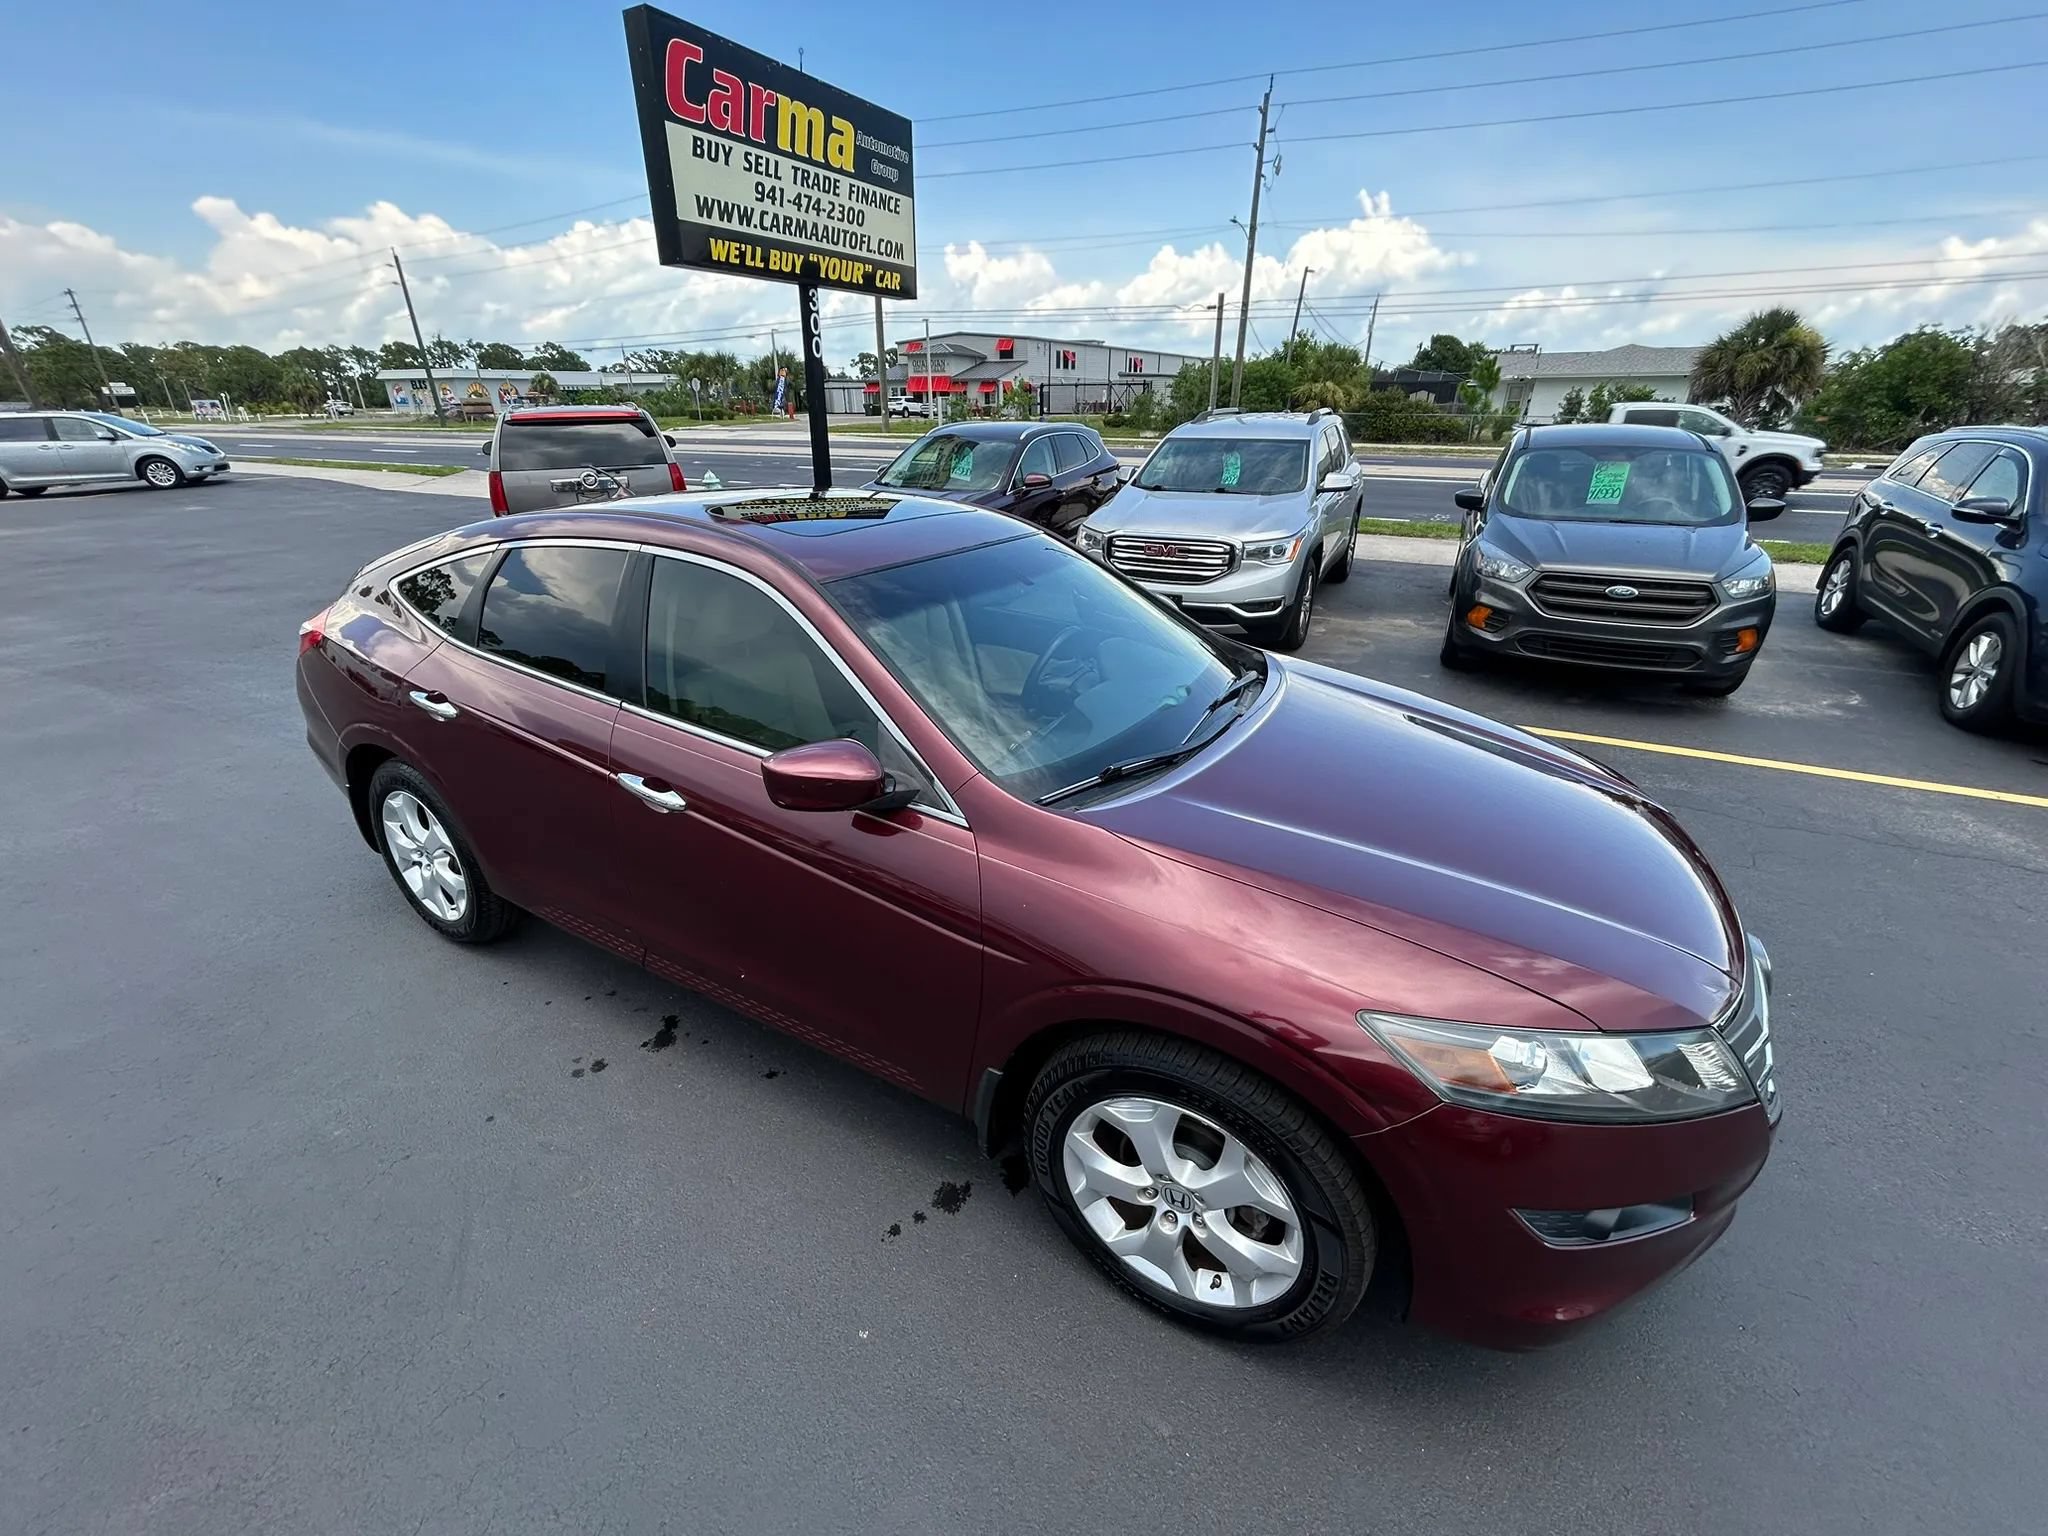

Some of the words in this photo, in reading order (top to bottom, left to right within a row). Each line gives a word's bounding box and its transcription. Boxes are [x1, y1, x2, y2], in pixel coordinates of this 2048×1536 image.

[665, 38, 855, 173] Carma
[856, 130, 910, 164] Automotive
[870, 158, 899, 183] Group
[692, 135, 733, 167] BUY
[743, 150, 782, 181] SELL
[791, 165, 841, 198] TRADE
[848, 183, 901, 215] FINANCE
[695, 194, 905, 261] WWW.CARMAAUTOFL.COM
[754, 181, 865, 228] 941-474-2300
[709, 237, 764, 269] WE'LL
[769, 250, 804, 275] BUY
[875, 269, 901, 291] CAR
[1144, 544, 1189, 560] GMC
[1279, 1267, 1341, 1334] RELIANT
